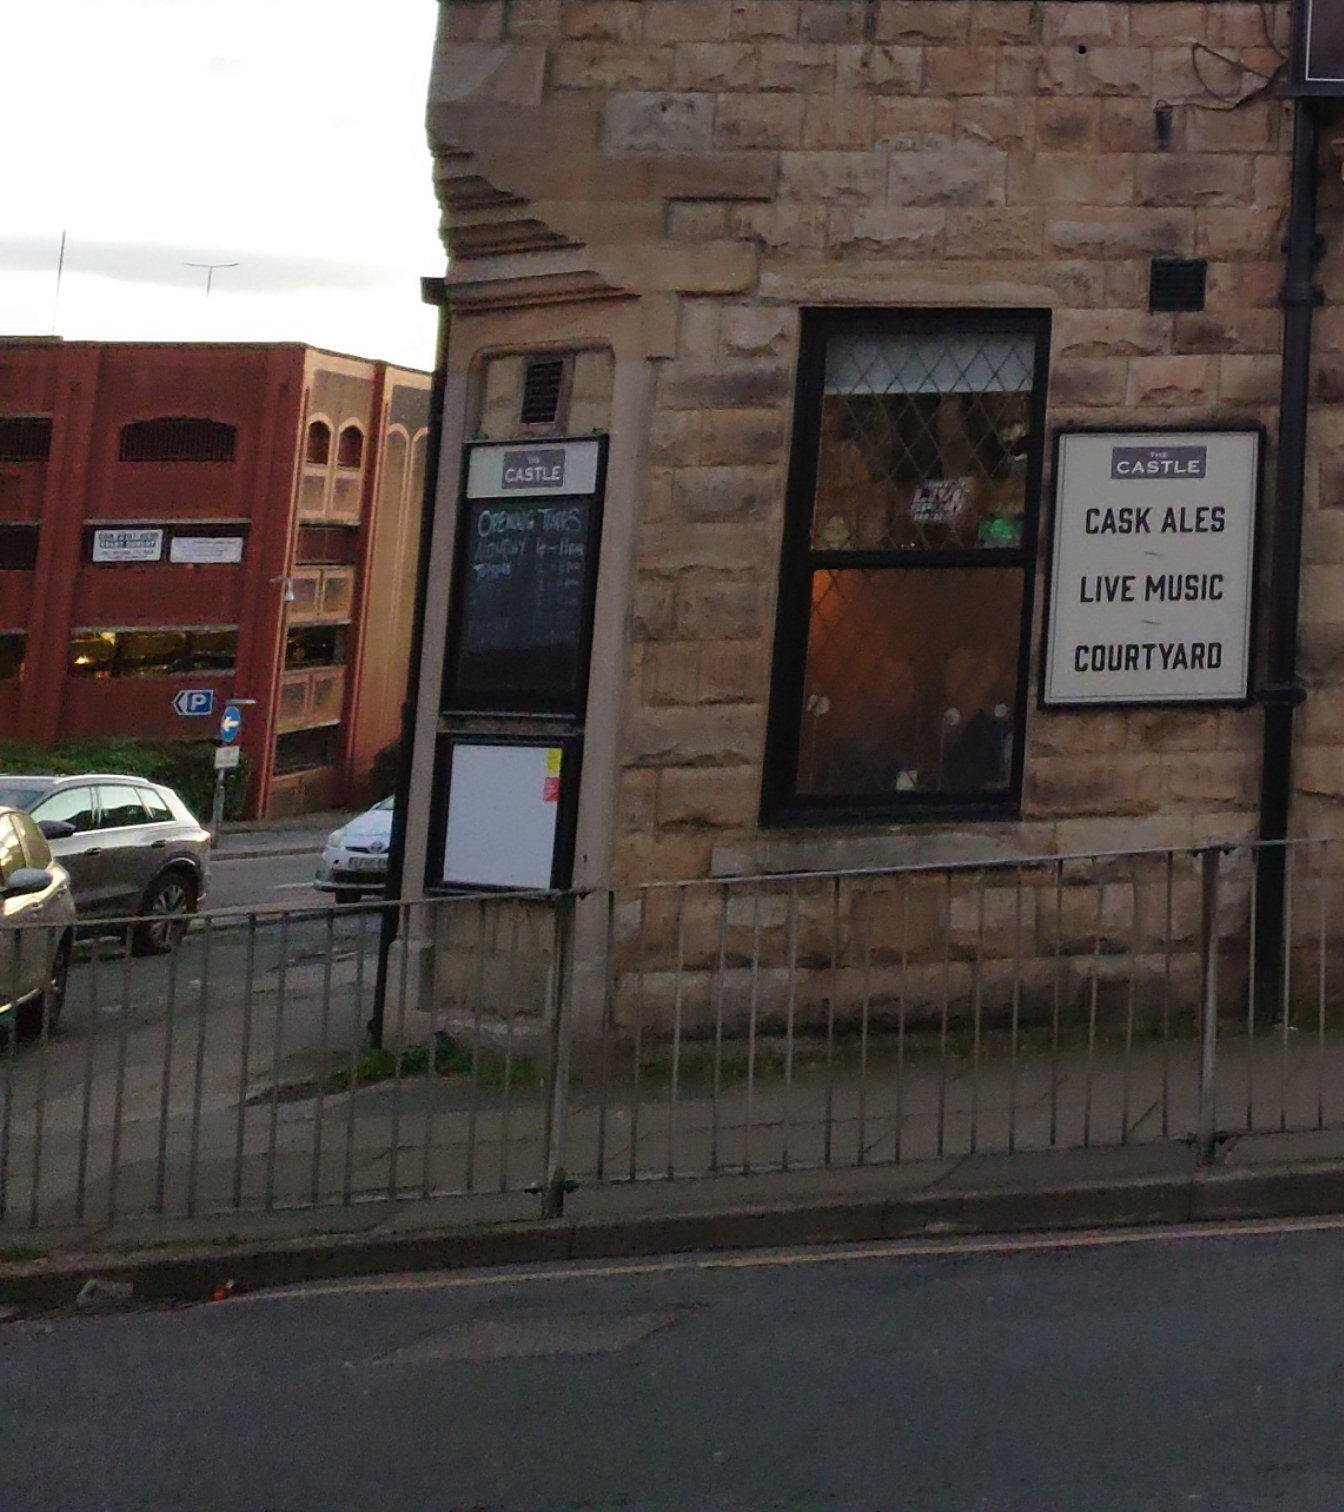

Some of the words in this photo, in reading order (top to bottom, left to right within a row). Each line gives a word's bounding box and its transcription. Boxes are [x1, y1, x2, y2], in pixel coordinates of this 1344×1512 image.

[504, 465, 561, 483] CASTLE
[1116, 459, 1201, 475] CASTLE
[1085, 507, 1152, 535] CASK
[1160, 506, 1226, 533] ALES
[1079, 575, 1136, 603] LIVE
[1144, 573, 1224, 601] MUSIC
[1074, 642, 1222, 672] COURTYARD
[190, 693, 208, 711] P
